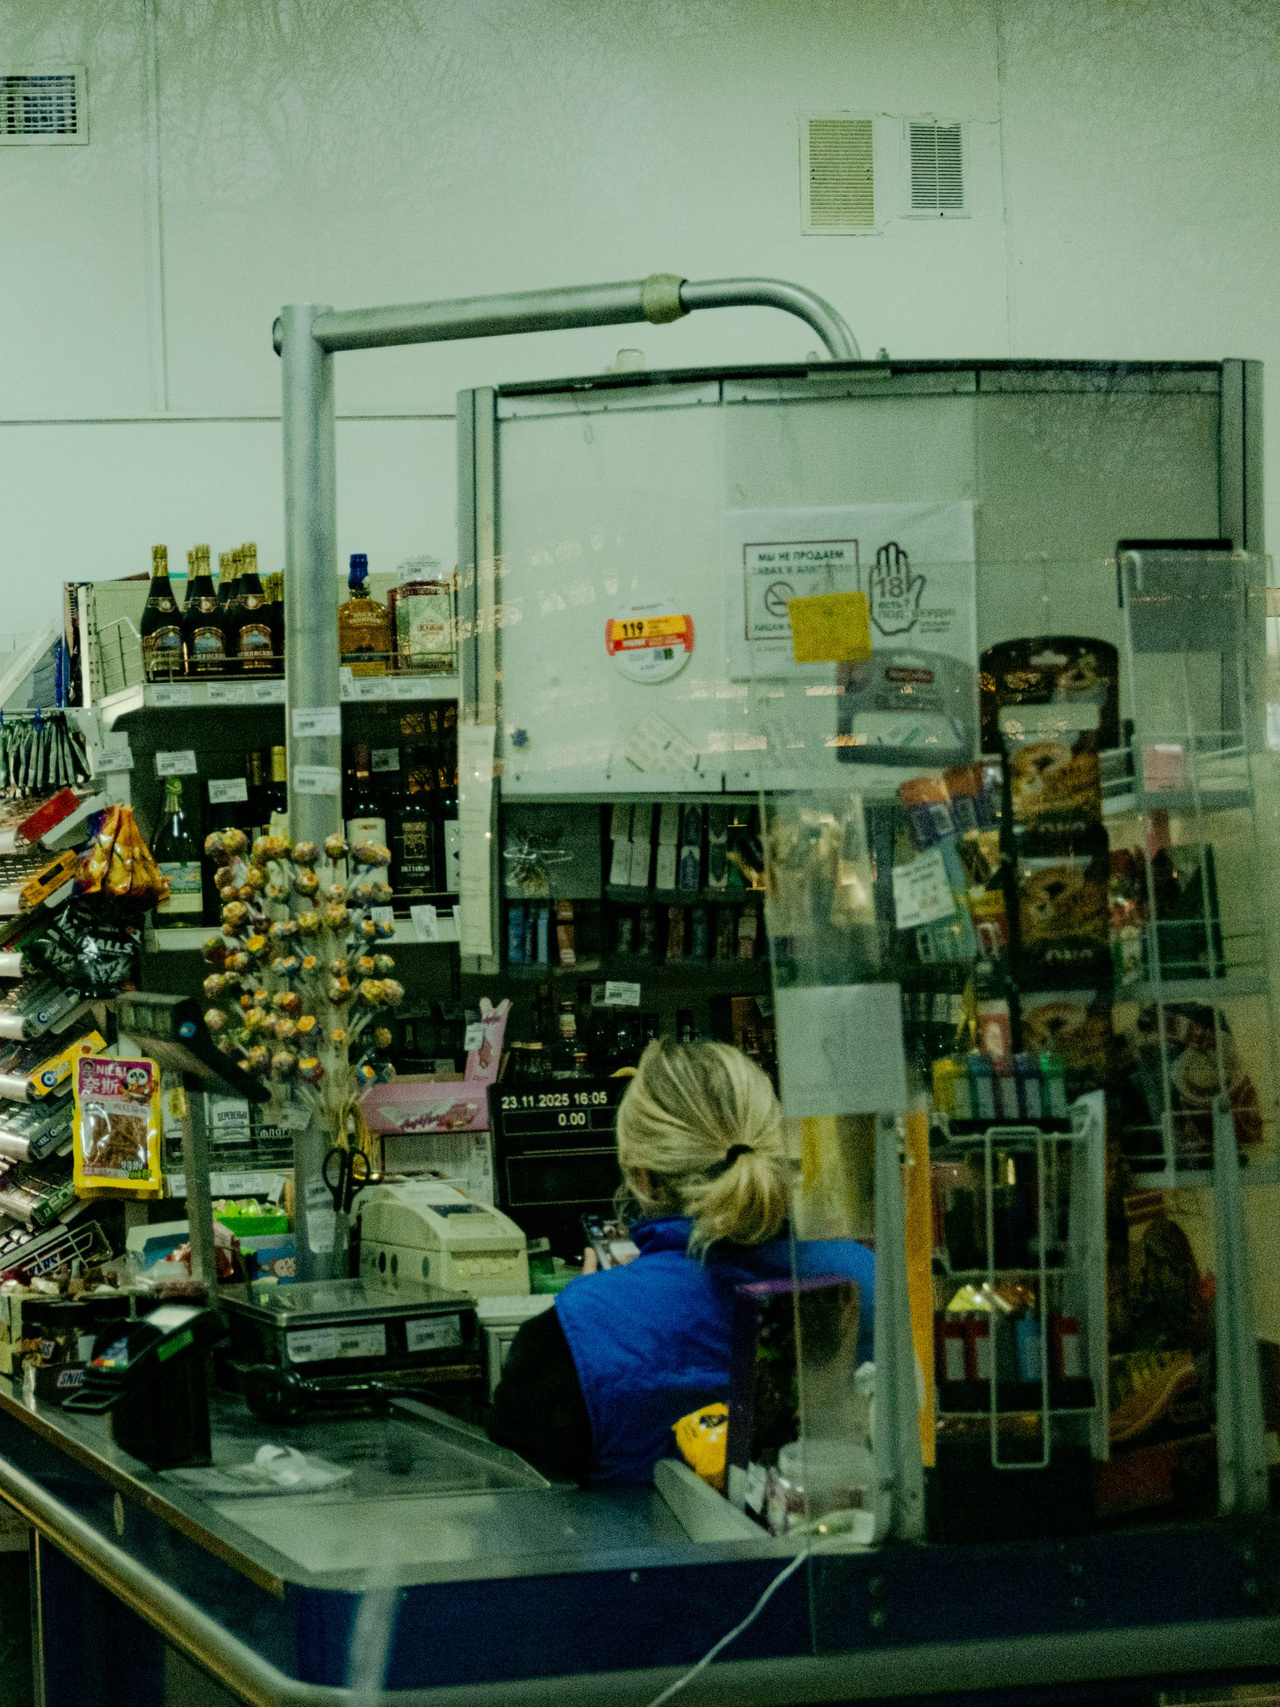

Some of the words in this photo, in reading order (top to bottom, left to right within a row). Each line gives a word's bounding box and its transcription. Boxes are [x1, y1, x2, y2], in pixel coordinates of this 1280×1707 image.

[758, 553, 775, 562] МЫ
[778, 552, 790, 560] НЕ
[793, 550, 844, 560] ПРОДАЕМ
[877, 576, 904, 598] 18
[622, 621, 644, 637] 119
[37, 1002, 62, 1023] Orbit
[501, 1094, 570, 1109] 23.11.2025
[573, 1091, 608, 1106] 16:05
[558, 1112, 586, 1127] 0.00
